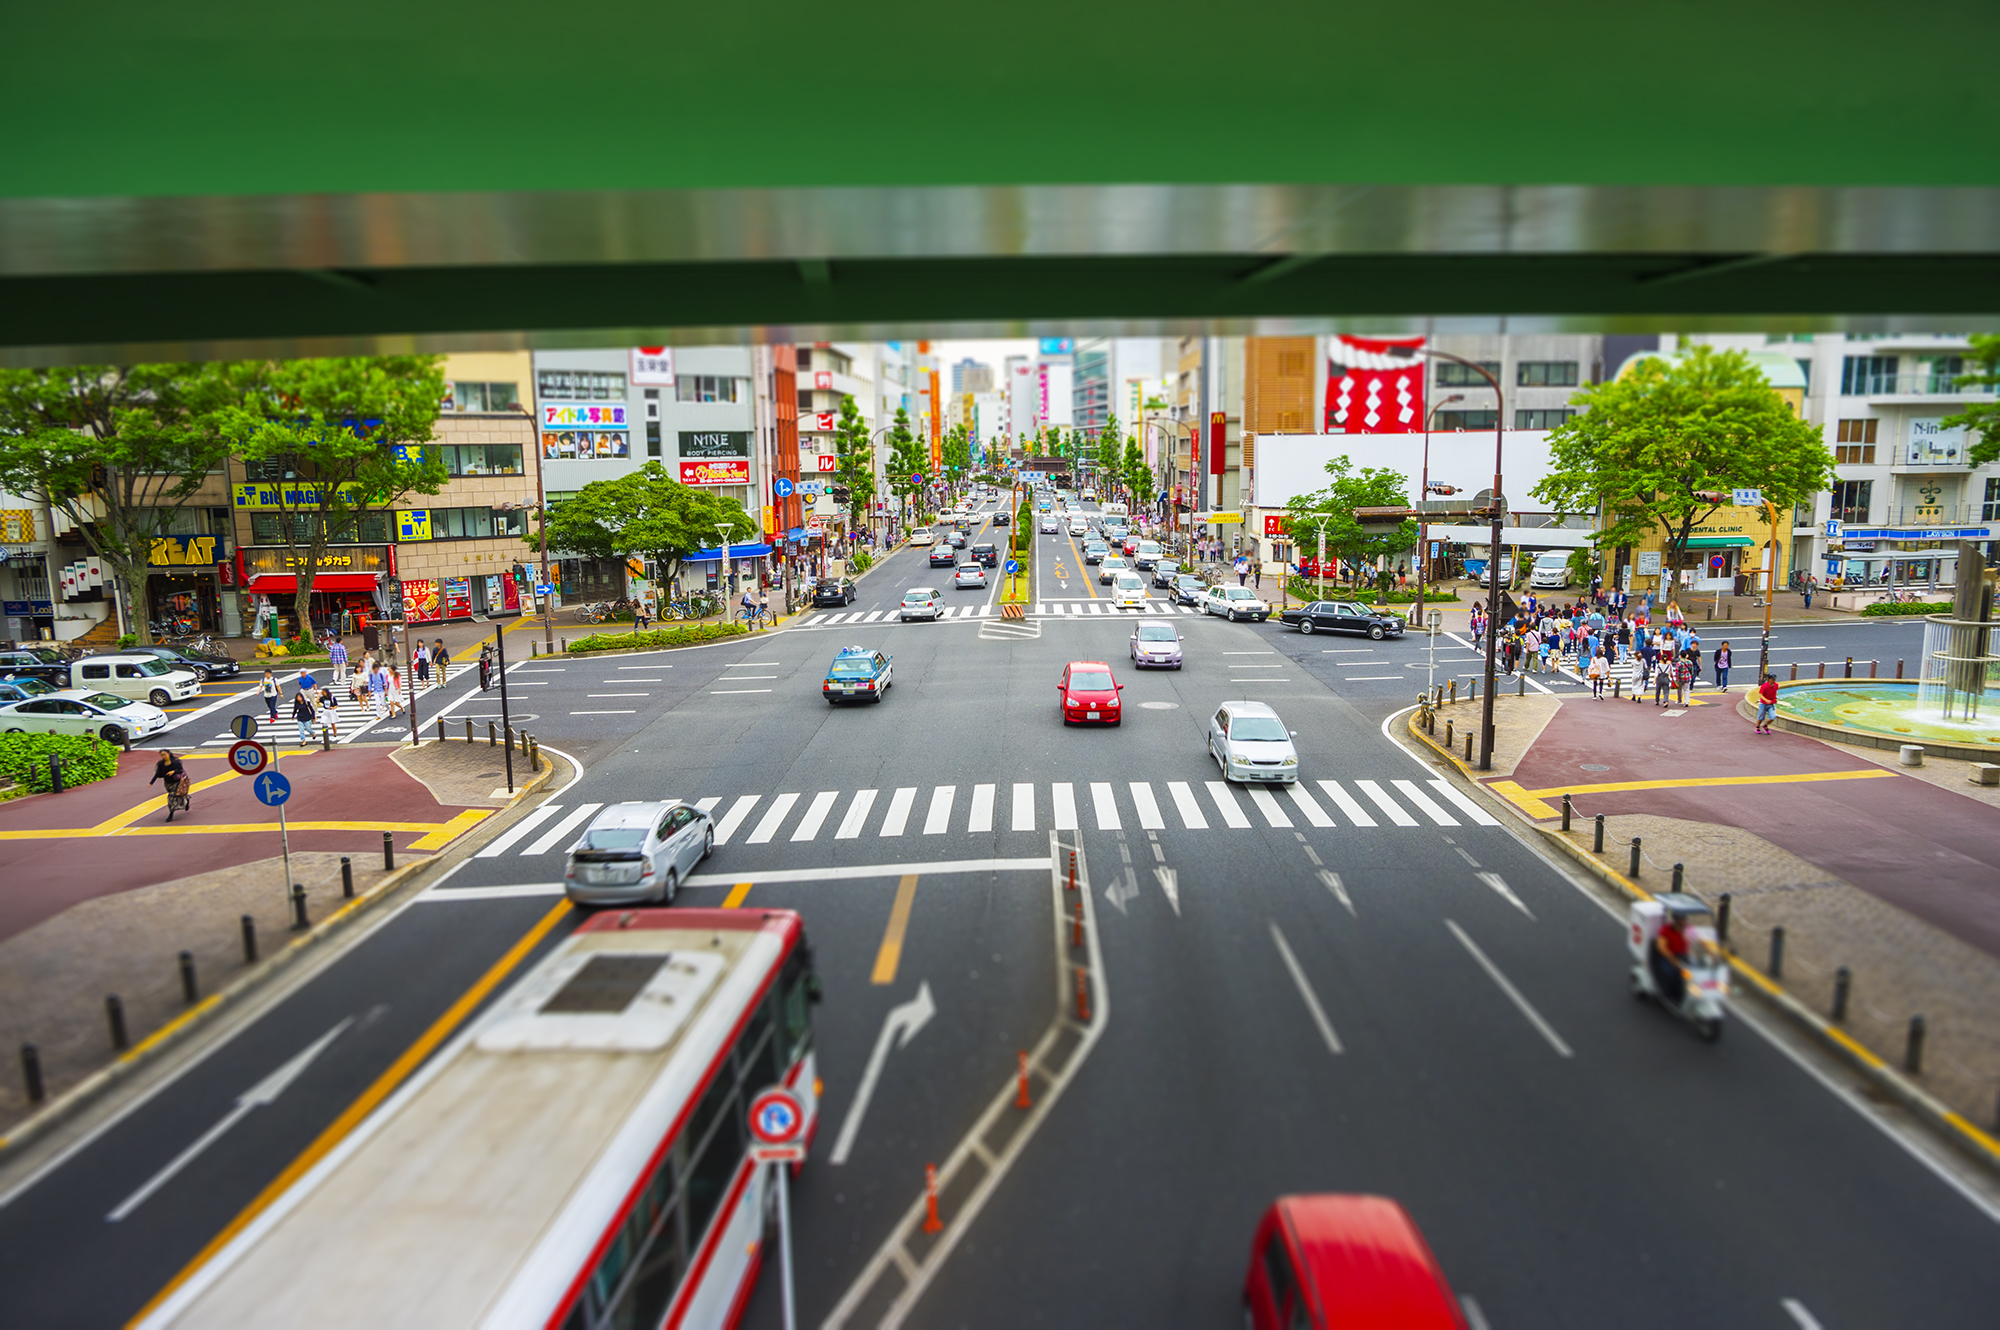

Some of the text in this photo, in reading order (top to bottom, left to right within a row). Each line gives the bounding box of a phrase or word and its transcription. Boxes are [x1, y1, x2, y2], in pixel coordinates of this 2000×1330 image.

[694, 434, 729, 445] NINE
[1718, 525, 1743, 533] CLINIC
[237, 750, 260, 766] 50
